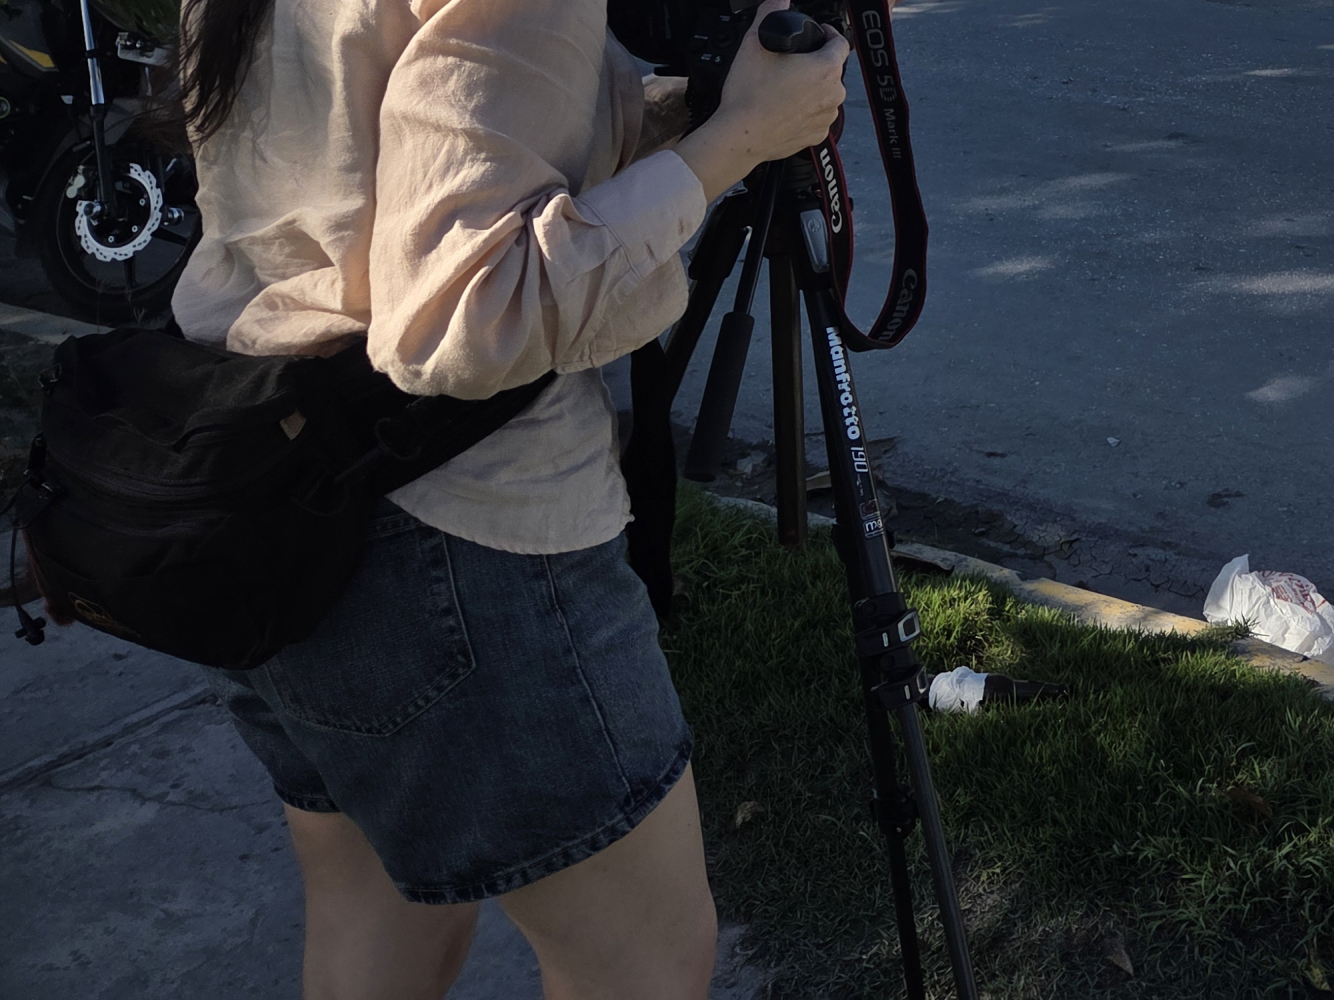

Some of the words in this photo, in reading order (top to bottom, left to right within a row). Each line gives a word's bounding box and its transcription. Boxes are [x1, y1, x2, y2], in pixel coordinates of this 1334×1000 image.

[861, 10, 890, 68] EOS
[883, 108, 899, 144] Mark
[819, 147, 843, 234] Canon
[877, 268, 918, 341] Canon
[825, 326, 861, 440] Manfrotto
[850, 446, 869, 473] 190
